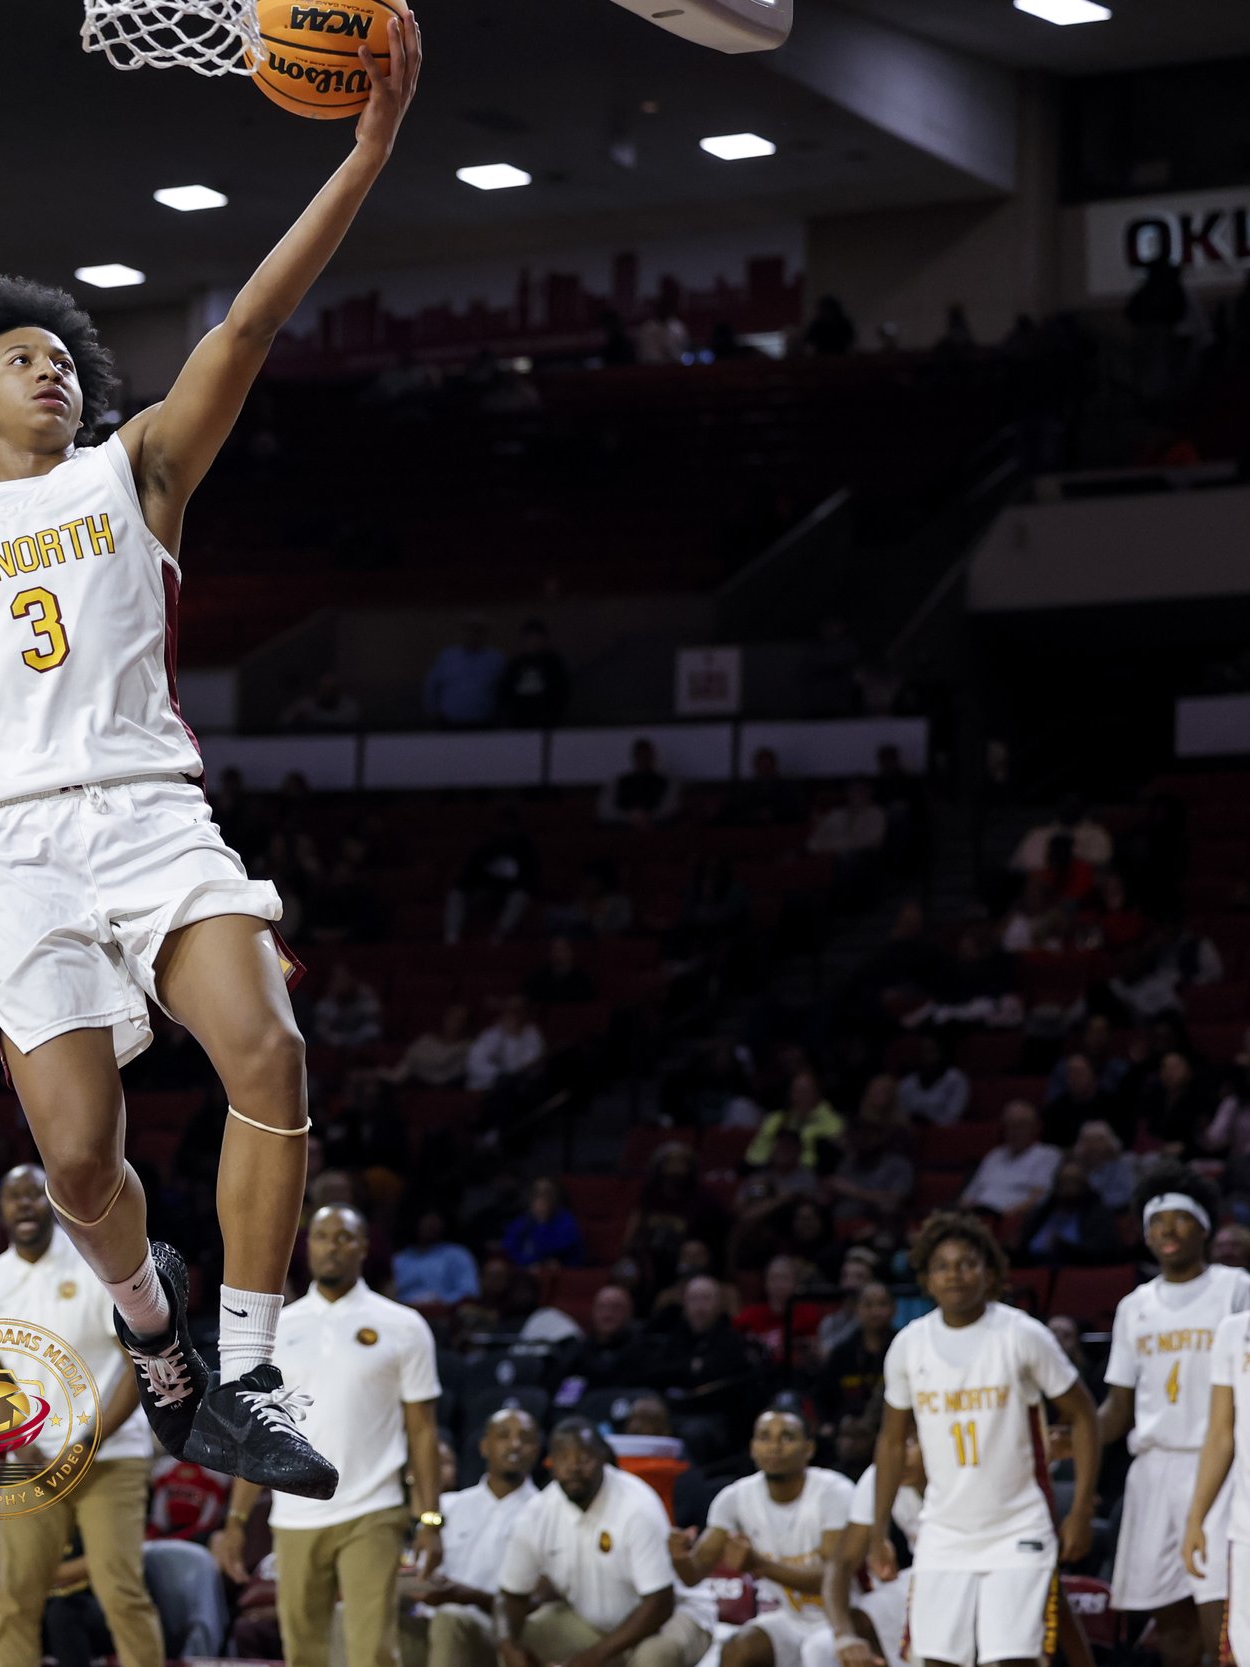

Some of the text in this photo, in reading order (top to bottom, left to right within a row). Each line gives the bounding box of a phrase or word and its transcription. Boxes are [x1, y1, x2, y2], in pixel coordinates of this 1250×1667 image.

[290, 5, 373, 40] NCAA
[269, 51, 372, 94] Wilson
[10, 586, 70, 674] 3
[916, 1391, 939, 1416] PC
[1165, 1358, 1180, 1405] 4
[950, 1421, 979, 1467] 11
